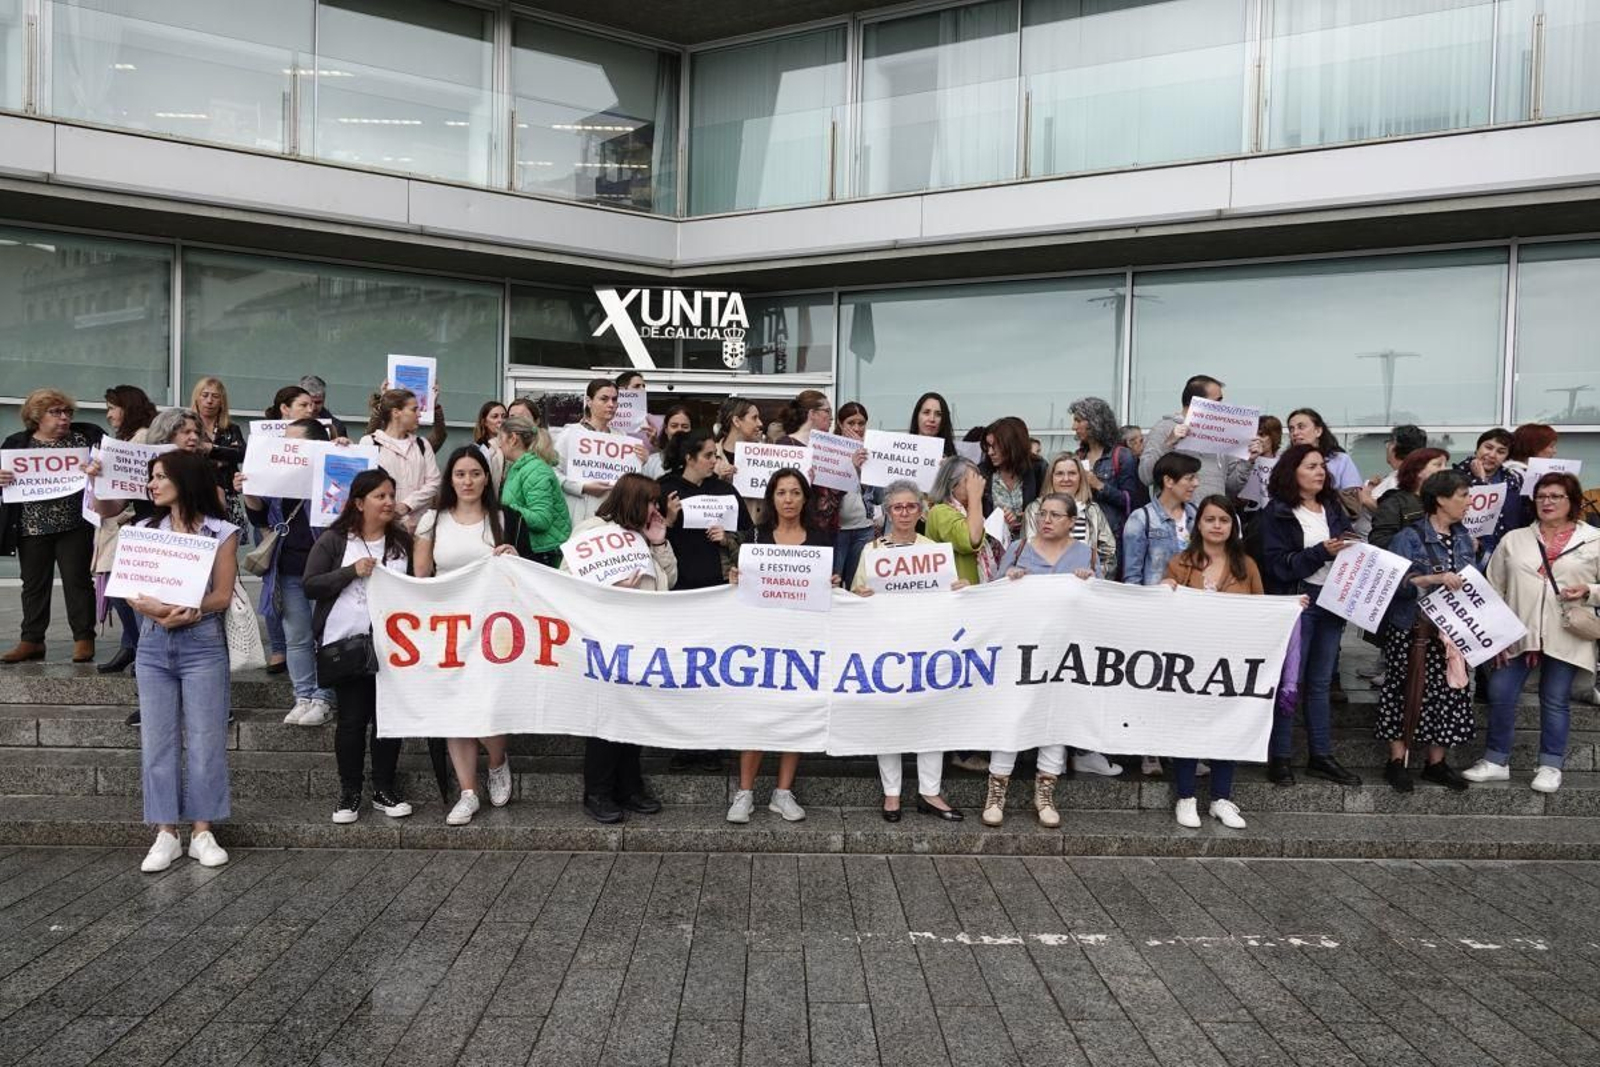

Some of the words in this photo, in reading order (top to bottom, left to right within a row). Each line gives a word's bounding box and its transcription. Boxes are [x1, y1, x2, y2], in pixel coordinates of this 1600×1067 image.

[592, 289, 750, 369] XUNTA
[641, 326, 660, 338] DE
[664, 327, 721, 341] GALICIA
[260, 423, 272, 431] OS
[284, 443, 299, 454] DE
[579, 438, 633, 460] STOP
[893, 441, 918, 452] HOXE
[136, 450, 147, 459] 11
[744, 446, 804, 460] DOMINGOS
[871, 451, 919, 465] TRABALLO
[923, 458, 936, 467] DE
[13, 456, 79, 474] STOP
[115, 456, 132, 465] SIN
[134, 459, 148, 467] PO
[271, 454, 309, 467] BALDE
[746, 458, 801, 470] TRABALLO
[113, 464, 148, 477] DISFRU
[573, 459, 637, 475] MARXINACION
[888, 466, 917, 478] BALDE
[9, 475, 84, 486] MARXINACION
[582, 470, 619, 481] LABORA
[111, 479, 146, 494] FEST
[750, 477, 768, 489] BA
[22, 487, 72, 496] LABORAL
[1469, 493, 1499, 511] OP
[1464, 513, 1495, 525] INACION
[121, 544, 132, 553] NIN
[575, 532, 636, 559] STOP
[751, 547, 764, 557] OS
[767, 548, 822, 560] DOMINGOS
[119, 558, 130, 566] NIN
[132, 559, 160, 570] CARTOS
[578, 552, 650, 577] MARXINACION
[760, 563, 766, 572] E
[768, 563, 812, 574] FESTIVOS
[875, 553, 947, 577] CAMP
[116, 572, 129, 581] NIN
[761, 577, 810, 588] TRABALLO
[885, 580, 939, 591] CHAPELA
[762, 591, 807, 601] GRATIS!!!
[1338, 581, 1353, 603] SOCIAL
[1438, 583, 1493, 648] TRABALLO
[1420, 597, 1438, 615] DE
[1434, 615, 1472, 656] BALDE
[385, 611, 571, 668] STOP
[1015, 643, 1274, 699] LABORAL
